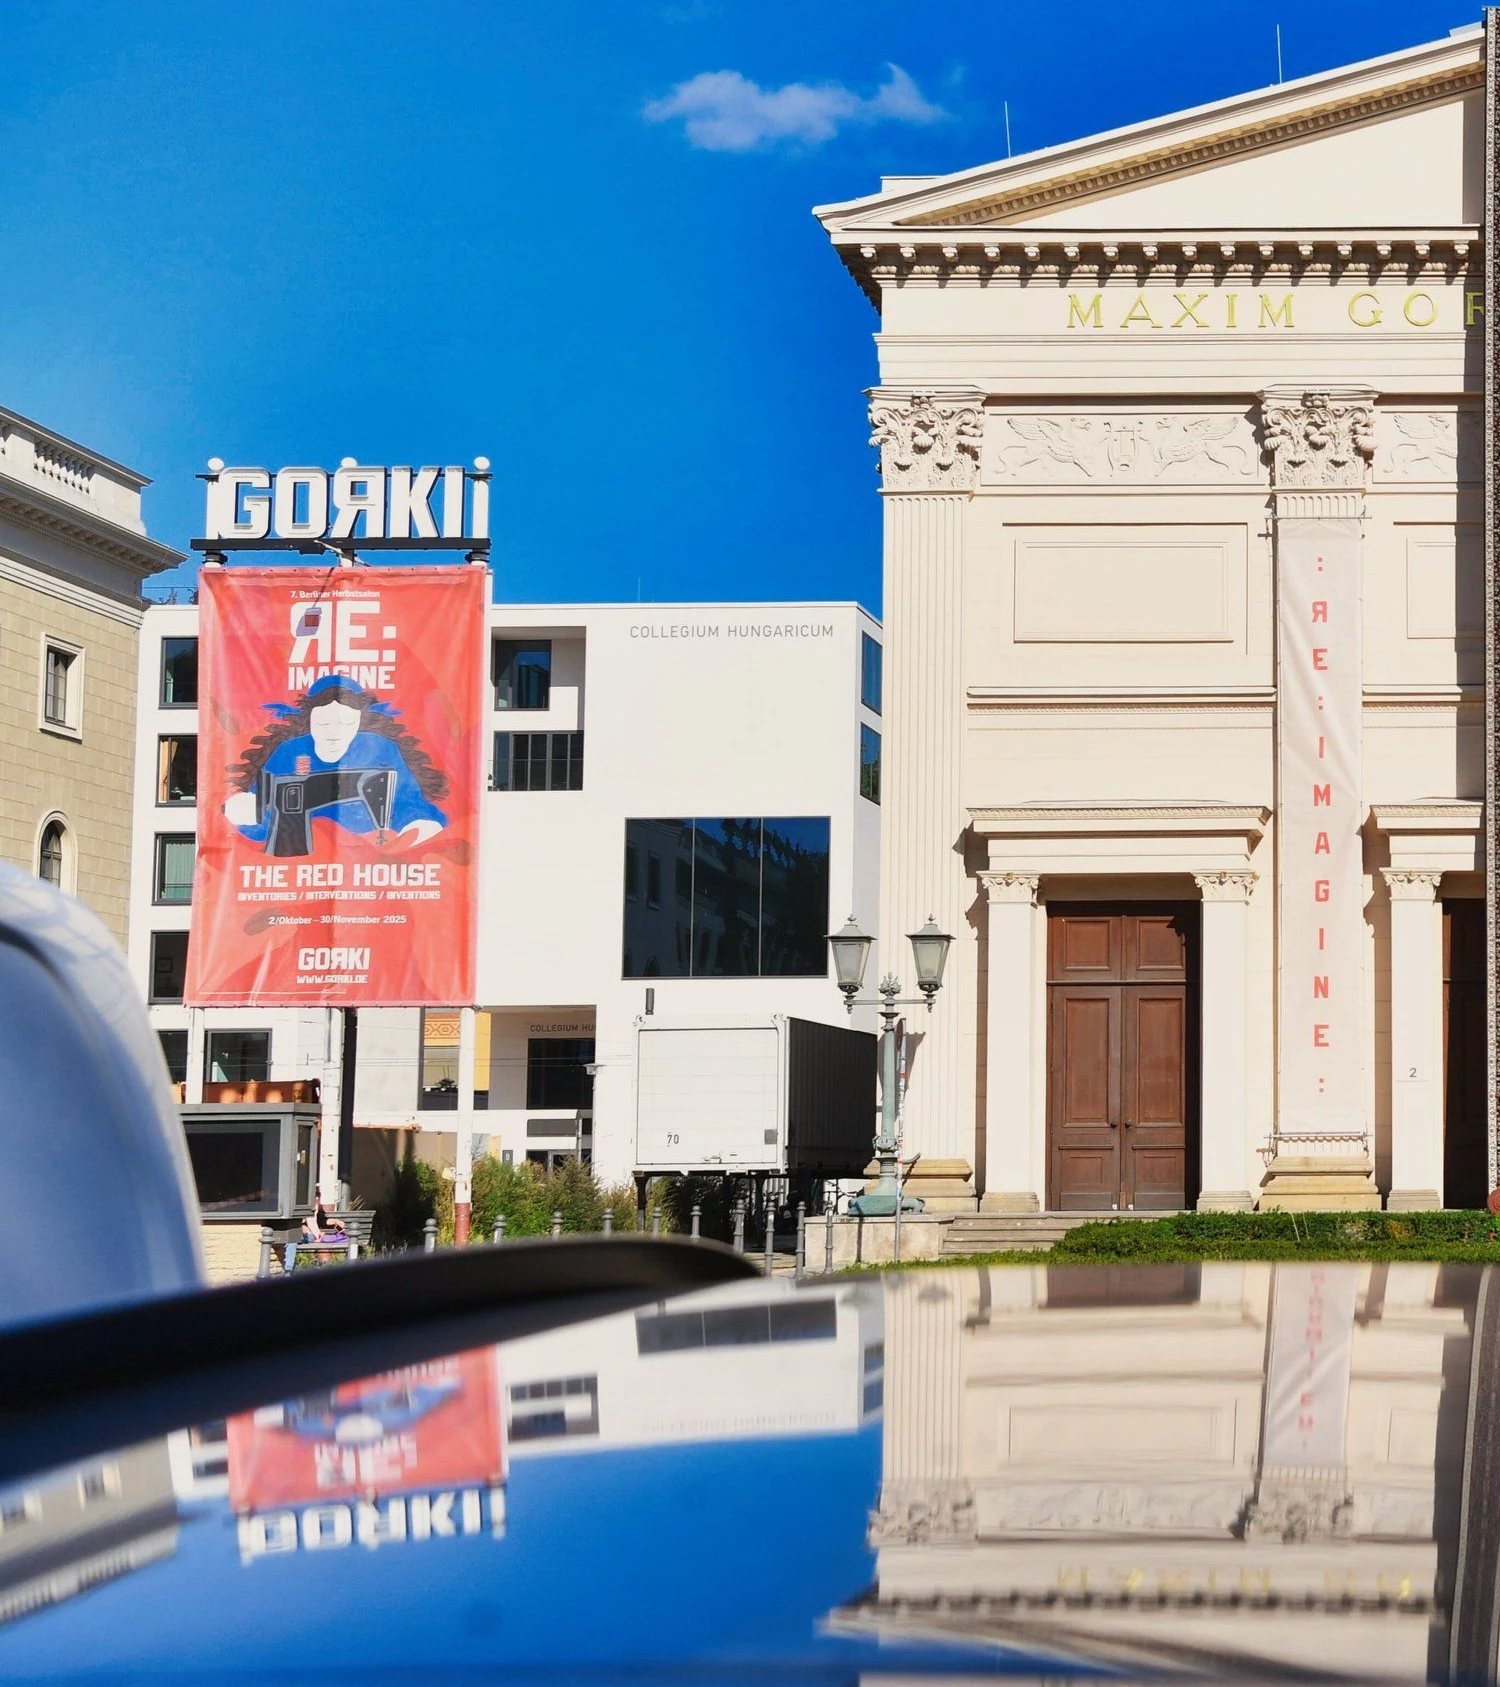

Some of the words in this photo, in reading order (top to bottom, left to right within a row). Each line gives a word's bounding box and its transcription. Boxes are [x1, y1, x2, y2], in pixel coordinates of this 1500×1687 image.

[1066, 292, 1295, 328] MAXIM
[300, 590, 331, 598] Berliner
[332, 589, 380, 598] Herbstsalon
[630, 625, 720, 638] COLLEGIUM
[727, 624, 833, 638] HUNGARICUM
[239, 865, 289, 888] THE
[296, 863, 344, 887] RED
[353, 863, 441, 887] HOUSE
[237, 891, 297, 901] INVENTORIES
[305, 890, 377, 900] INTERVENTIONS
[386, 890, 441, 900] INVENTIONS
[383, 915, 407, 924] 2025
[296, 975, 369, 984] WWW.GORKI.DE
[530, 1024, 579, 1032] COLLEGIUM
[1409, 1067, 1417, 1078] 2
[667, 1134, 680, 1144] 70
